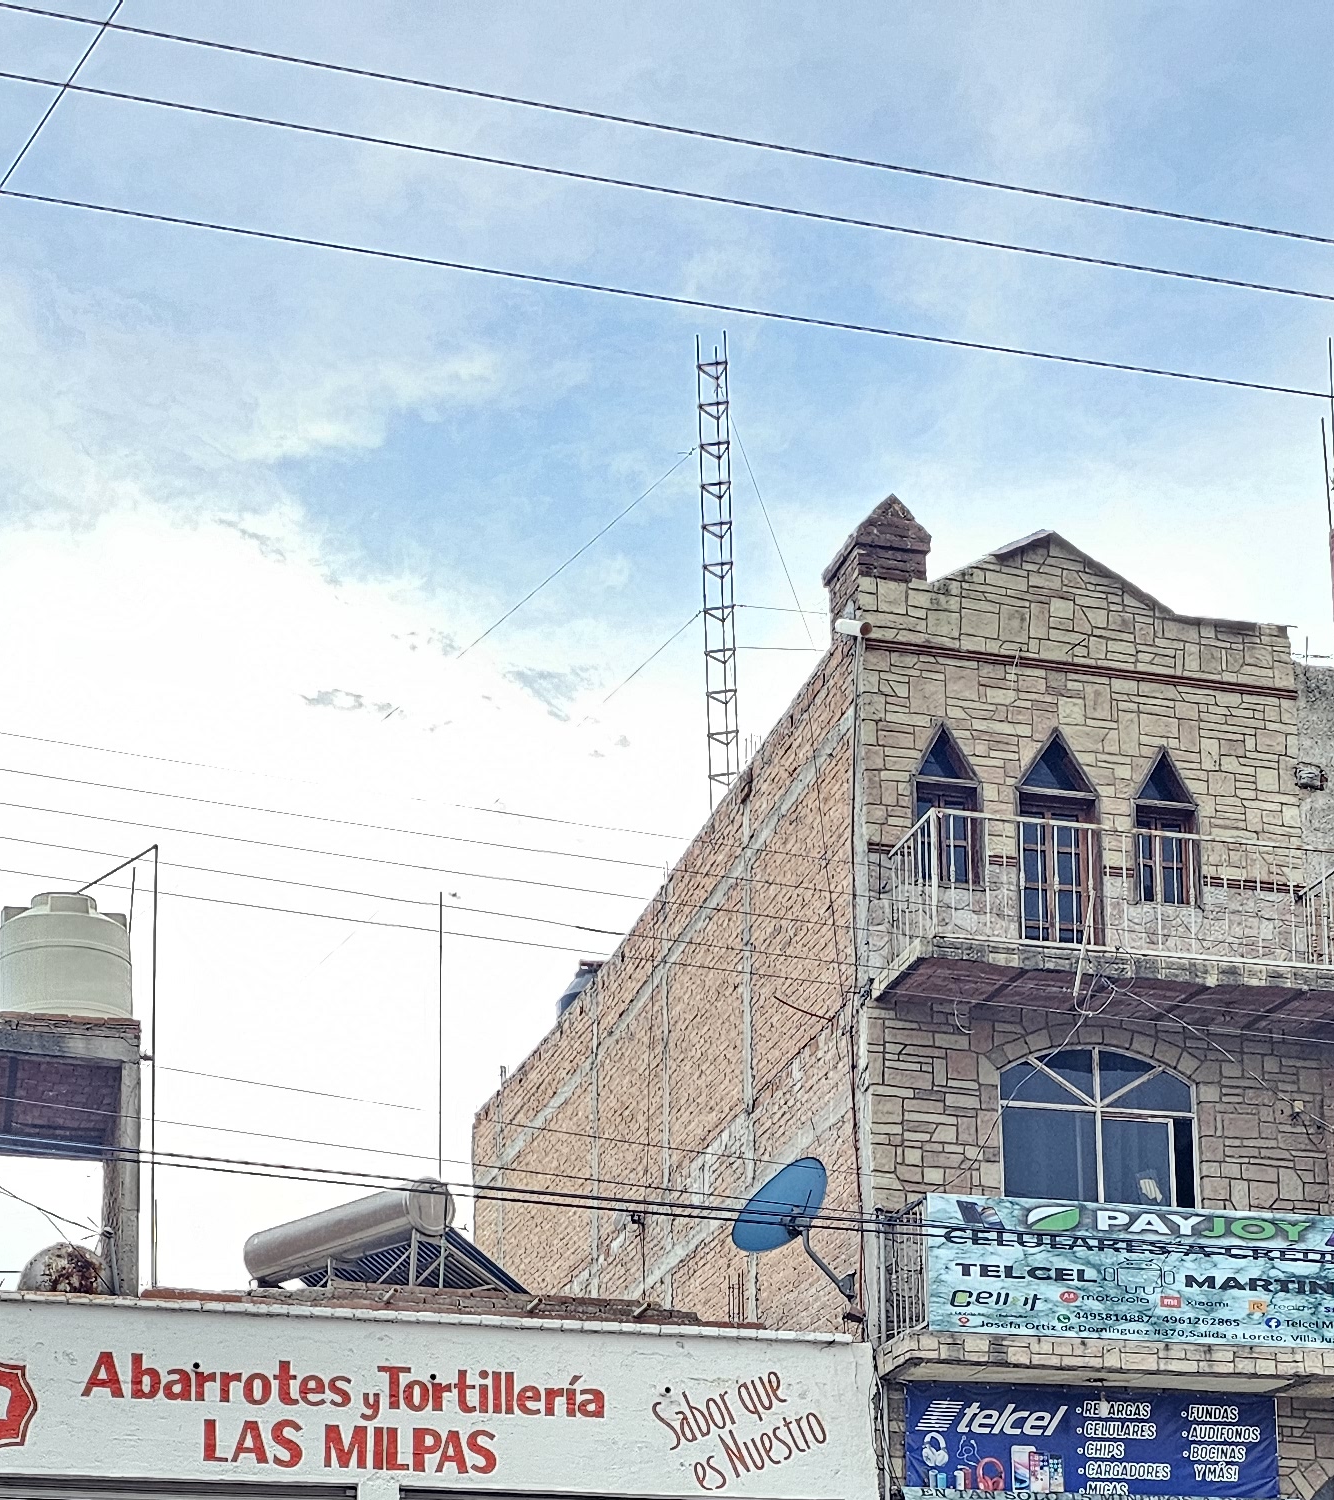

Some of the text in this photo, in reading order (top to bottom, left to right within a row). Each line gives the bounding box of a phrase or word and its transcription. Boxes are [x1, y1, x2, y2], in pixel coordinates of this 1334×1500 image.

[1096, 1210, 1311, 1242] PAYJOY
[943, 1227, 1169, 1256] CELULARES
[955, 1262, 1098, 1283] TELCEL
[1081, 1294, 1150, 1305] motorola
[1074, 1311, 1240, 1327] 4495814887 4961262865
[1284, 1319, 1319, 1330] Telcel
[979, 1320, 1021, 1331] Josefa
[1024, 1322, 1057, 1332] Ortiz
[1060, 1323, 1075, 1332] de
[1291, 1334, 1318, 1343] Villa
[80, 1351, 606, 1421] Abarrotes y Tortillería
[651, 1371, 788, 1451] Sabor que
[1082, 1400, 1152, 1418] REARGAS
[1188, 1404, 1239, 1422] FUNDAS
[956, 1402, 1069, 1436] telcel
[1084, 1421, 1157, 1439] CELULARES
[1188, 1425, 1261, 1443] AUDIFONOS
[203, 1418, 498, 1475] LAS MILPAS
[693, 1412, 828, 1491] es Nuestro
[1085, 1441, 1125, 1458] CHIPS
[1190, 1444, 1247, 1462] BOCINAS
[1085, 1461, 1172, 1480] CARGADORES
[1194, 1461, 1239, 1482] Y MÁS!
[920, 1488, 947, 1498] EN
[953, 1490, 997, 1500] TAN
